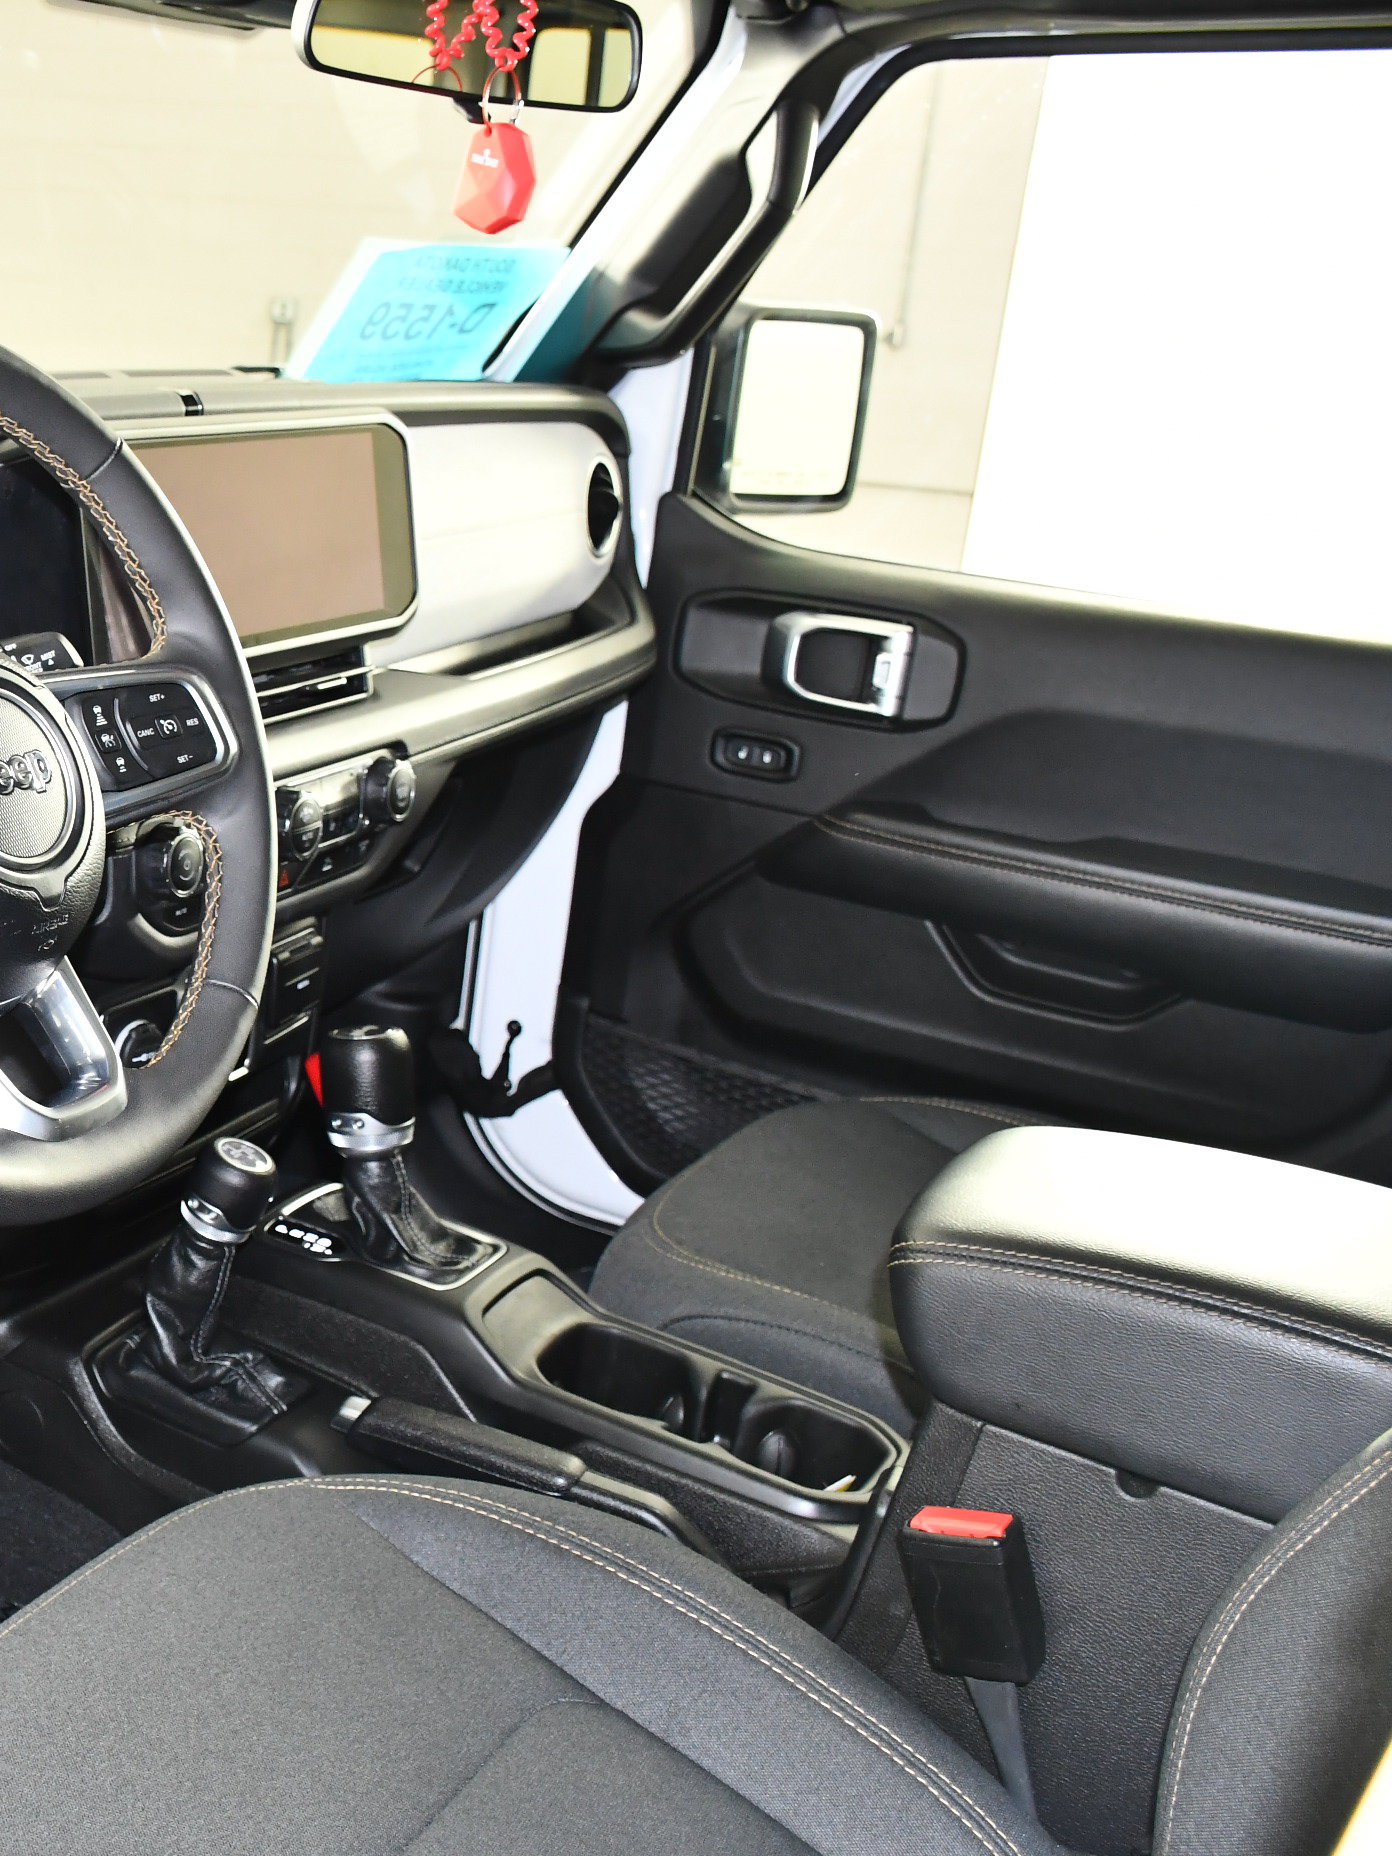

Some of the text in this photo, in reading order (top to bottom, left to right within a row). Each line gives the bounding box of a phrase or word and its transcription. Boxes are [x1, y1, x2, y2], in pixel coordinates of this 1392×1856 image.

[149, 693, 165, 702] SET+
[185, 717, 199, 727] RES
[137, 728, 155, 738] CANC
